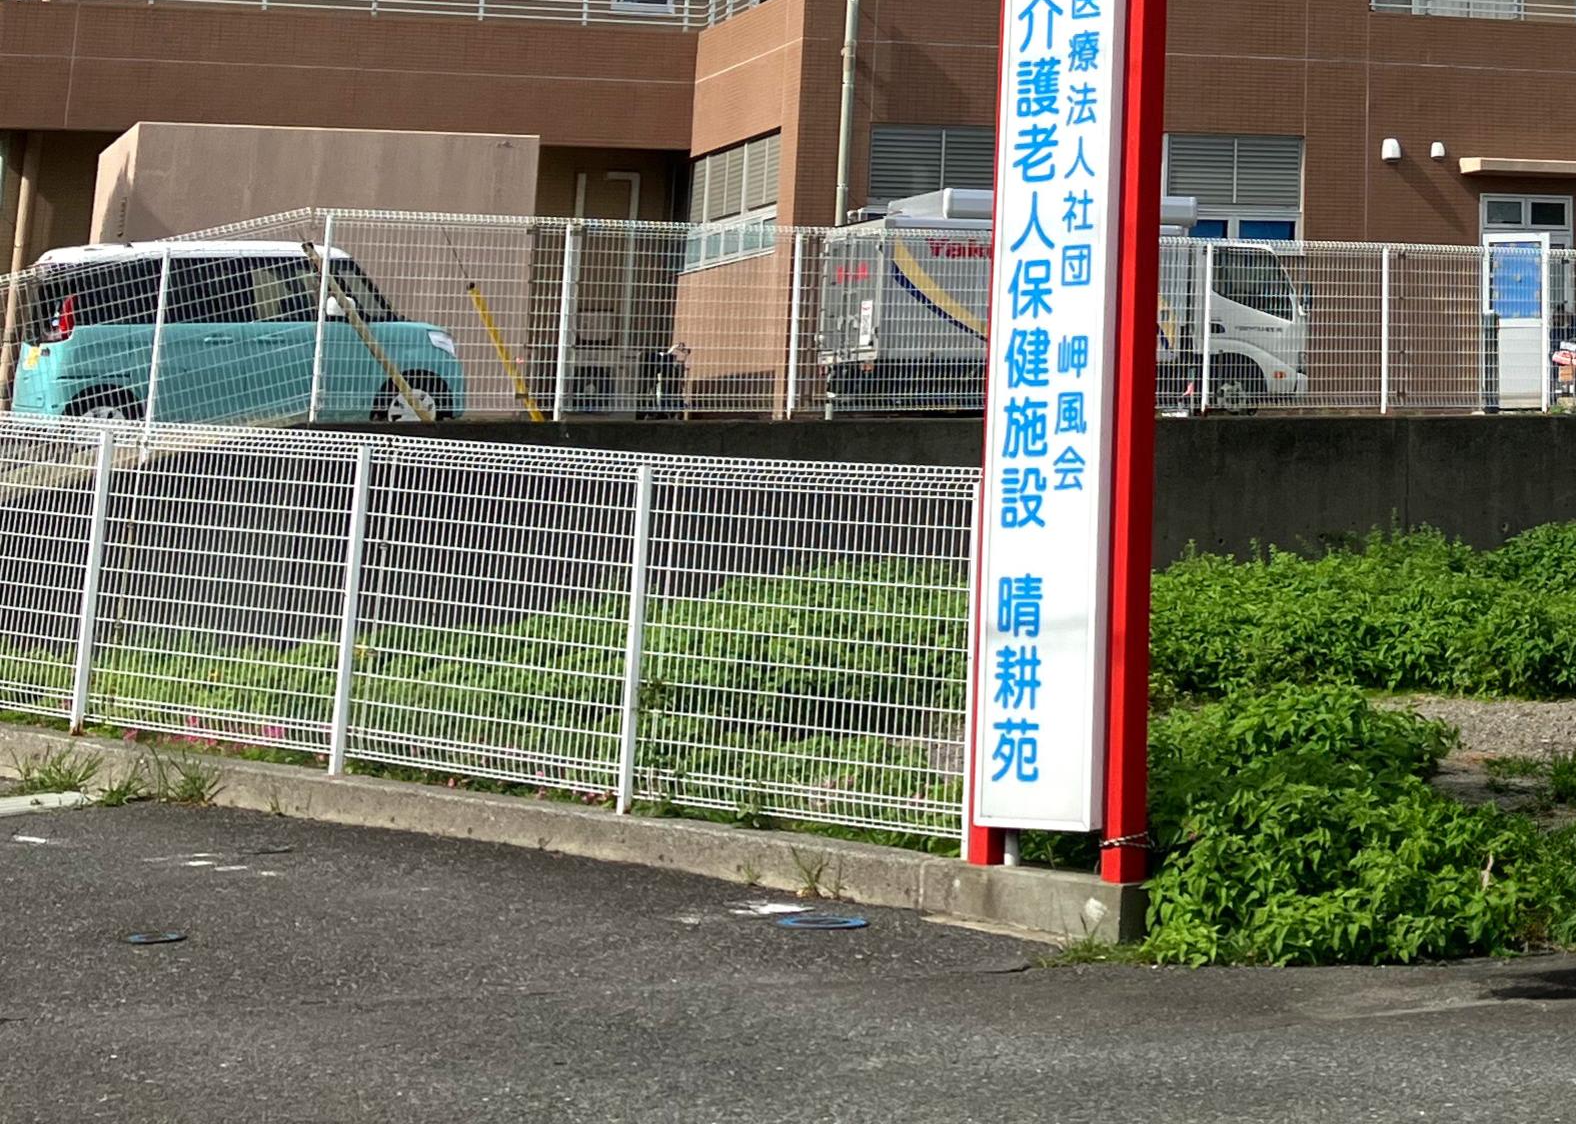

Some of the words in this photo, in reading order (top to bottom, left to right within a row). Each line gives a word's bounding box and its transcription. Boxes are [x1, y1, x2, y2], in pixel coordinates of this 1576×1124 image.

[1053, 334, 1089, 491] 岬風会
[991, 573, 1044, 783] 晴耕苑
